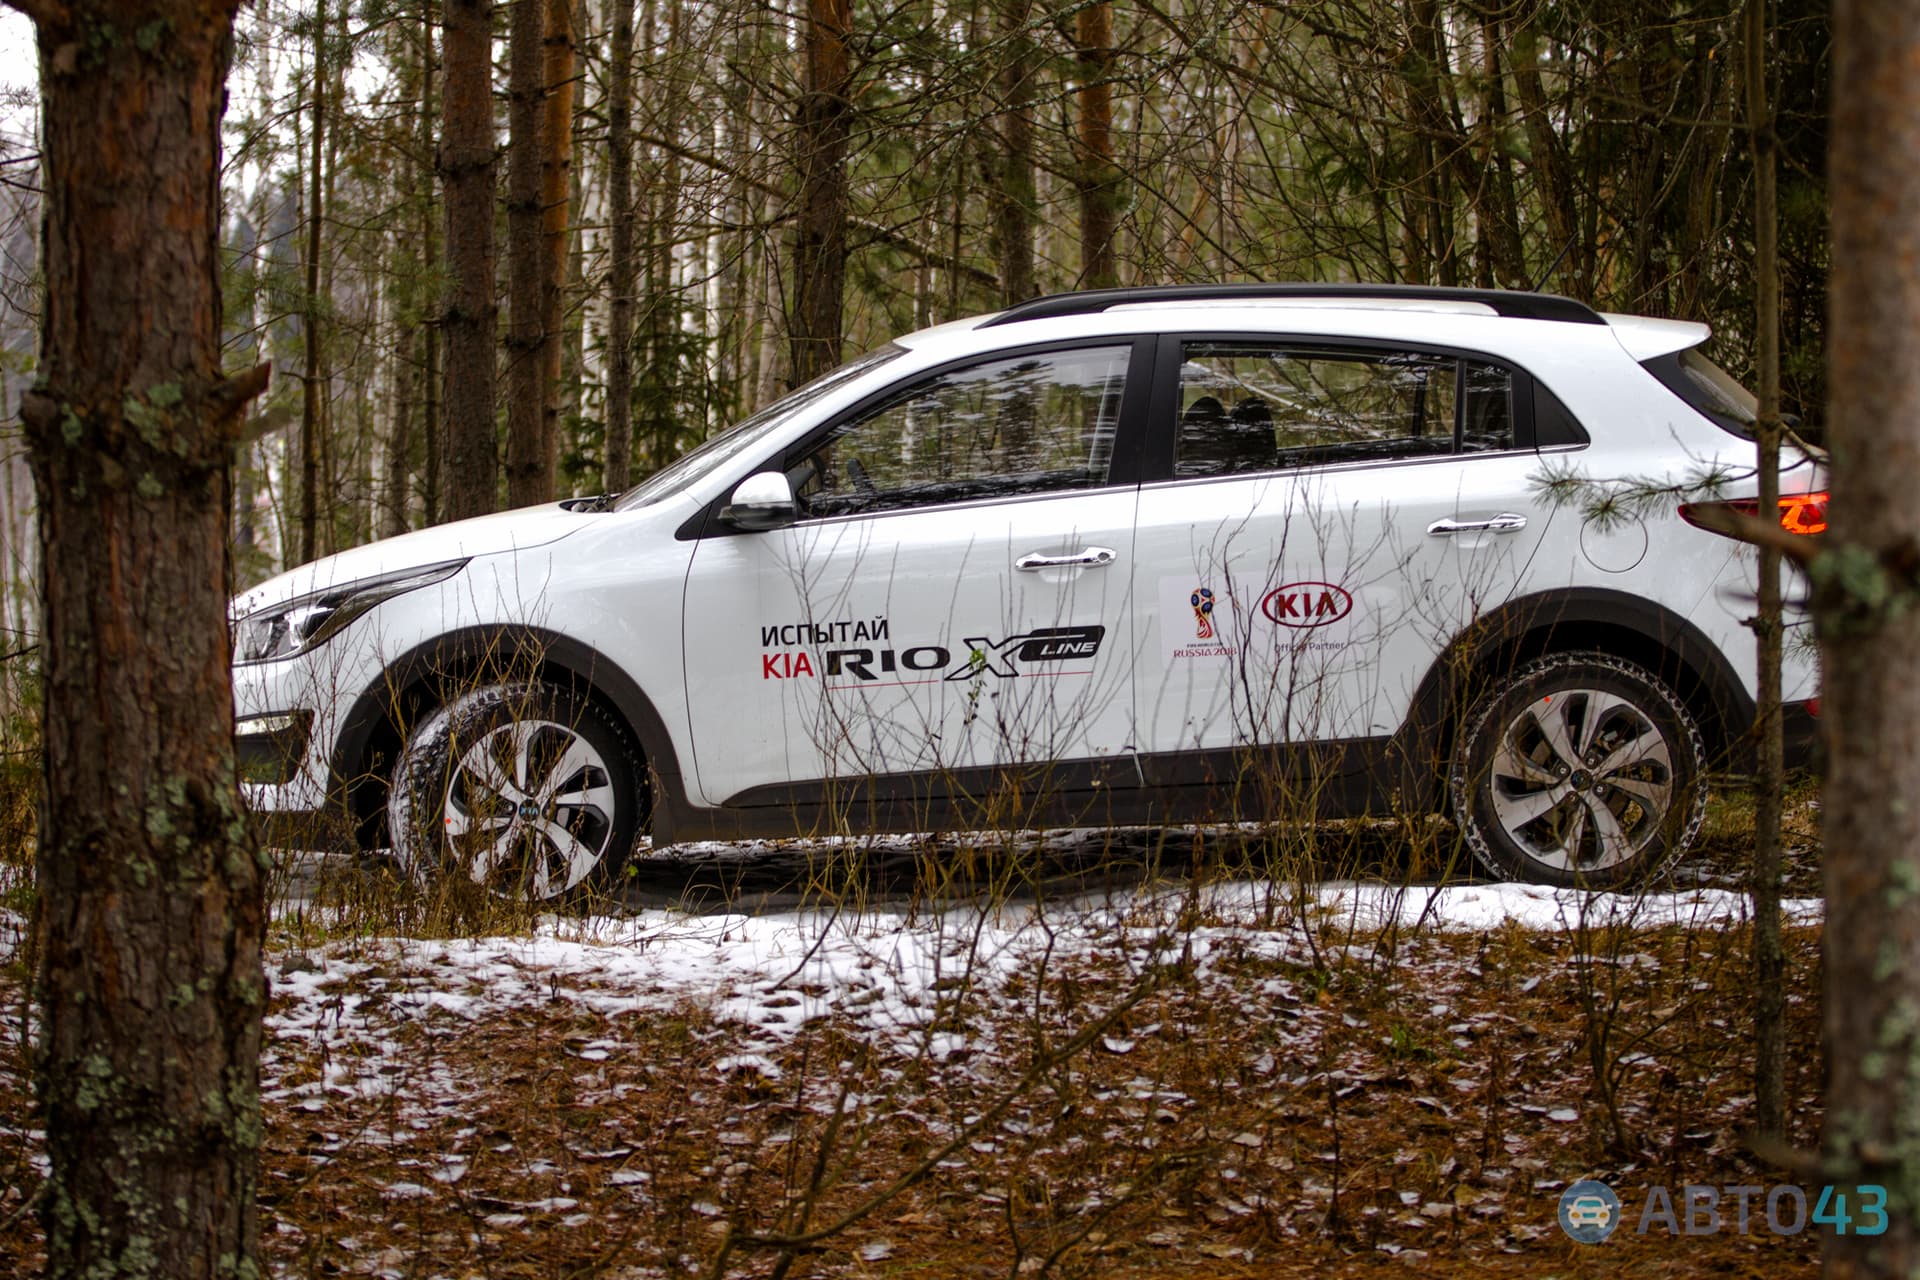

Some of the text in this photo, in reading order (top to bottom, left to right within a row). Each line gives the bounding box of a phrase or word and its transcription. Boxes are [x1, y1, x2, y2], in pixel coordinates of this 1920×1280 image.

[1278, 592, 1338, 618] KIA
[762, 616, 888, 647] ИСПЫТАЙ
[763, 652, 814, 680] KIA
[827, 646, 950, 681] RIO
[1040, 641, 1096, 656] LINE
[1173, 648, 1212, 658] RUSSIA
